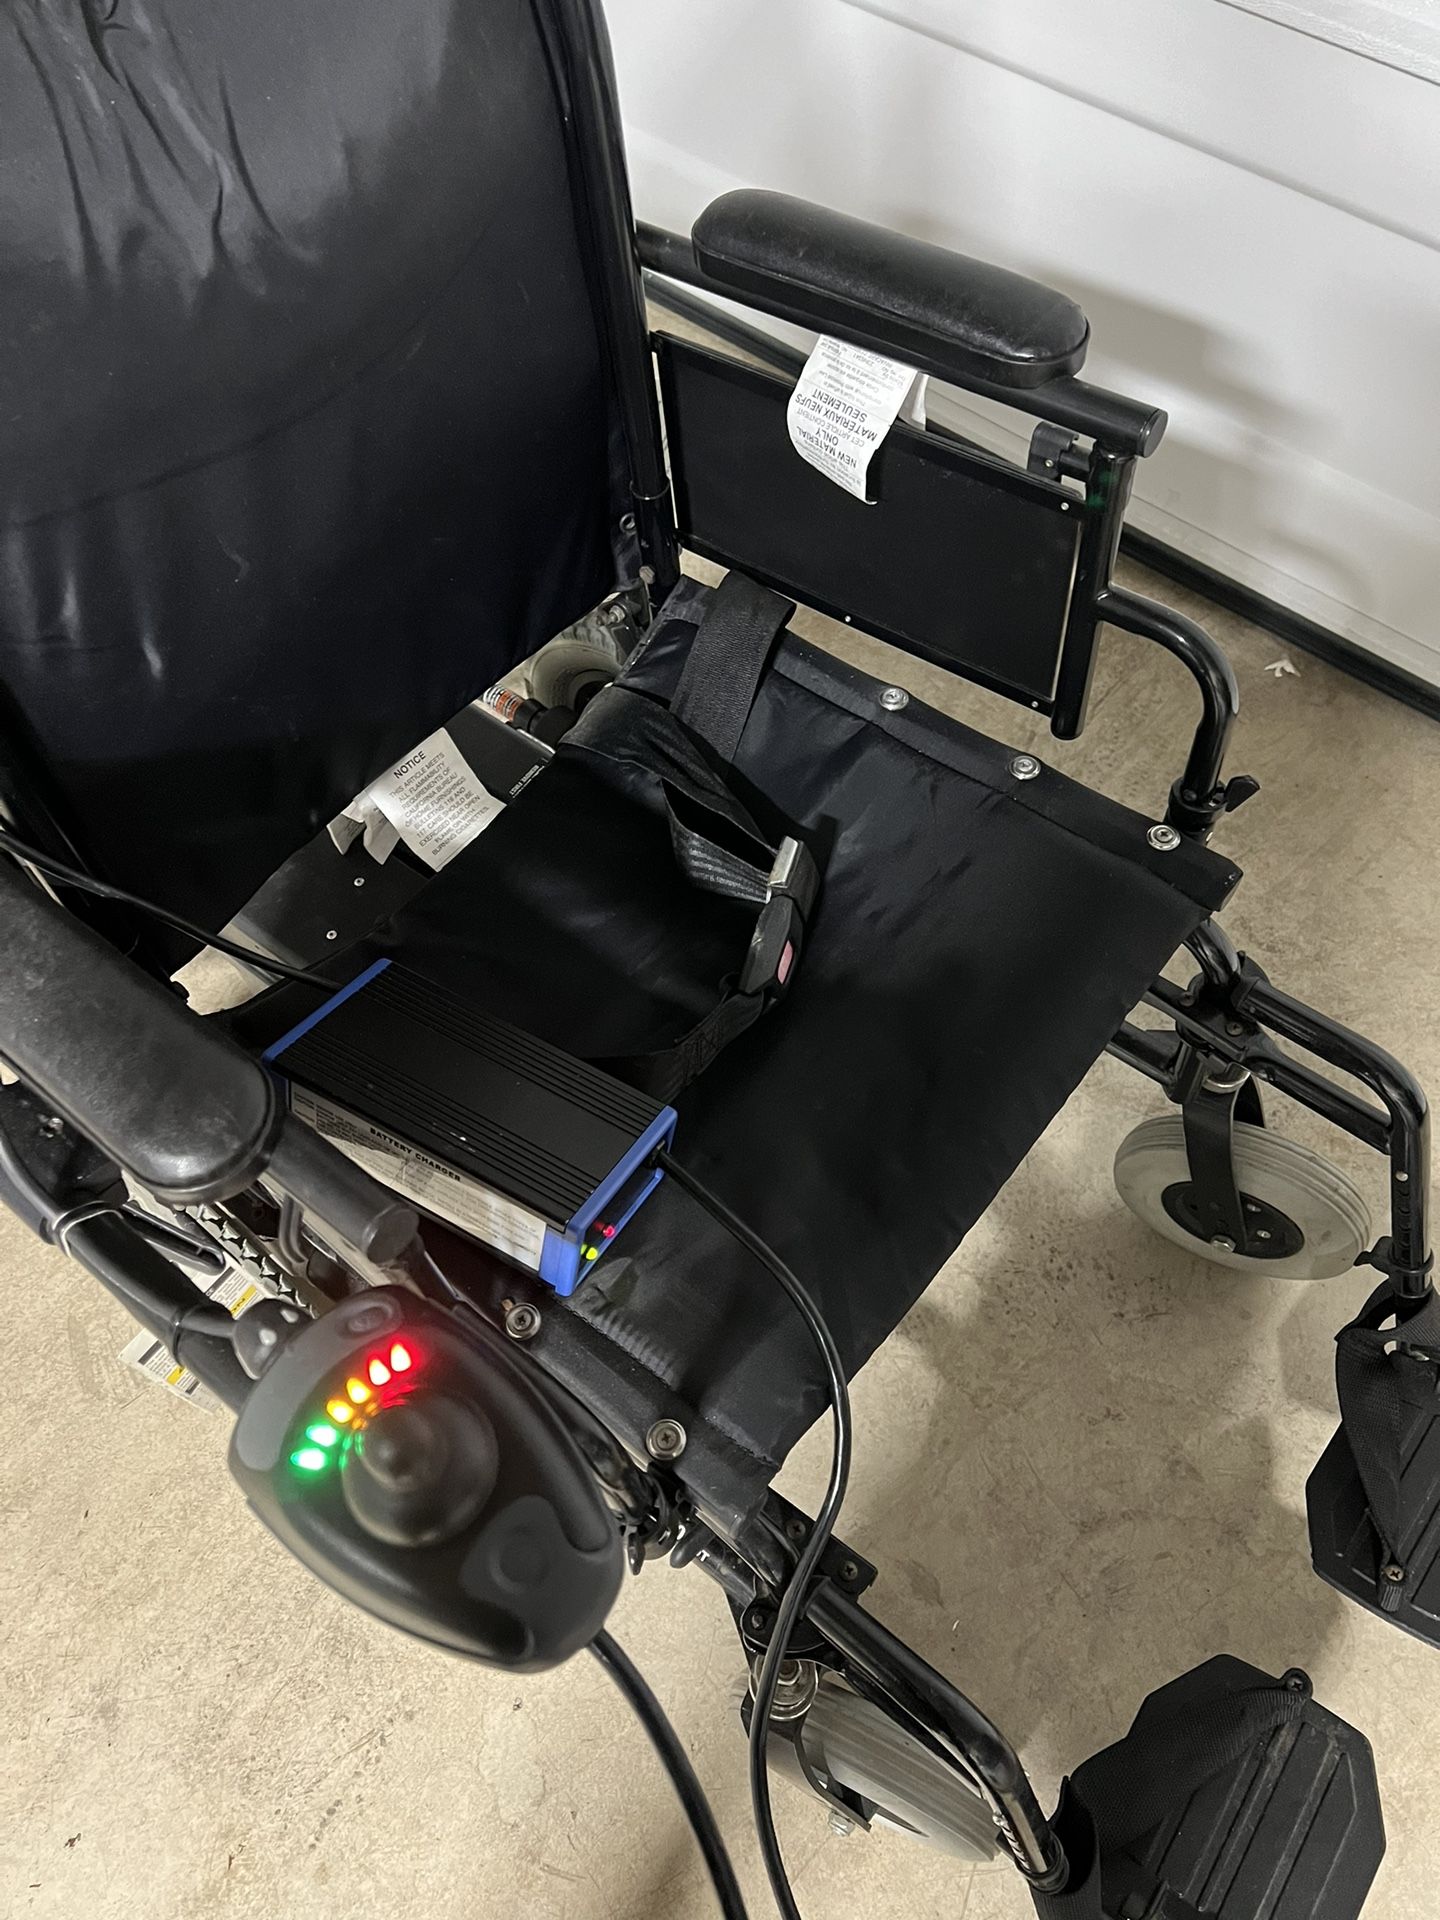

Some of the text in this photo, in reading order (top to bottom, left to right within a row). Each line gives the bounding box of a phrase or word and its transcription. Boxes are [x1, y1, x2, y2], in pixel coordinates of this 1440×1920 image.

[794, 393, 877, 442] MATÉRIAUX NEUFS
[810, 387, 867, 423] SEULEMENT
[793, 425, 856, 467] NEW MATERIAL
[795, 406, 865, 447] CET ARTICLE CONTIENT
[814, 426, 839, 446] ONLY
[389, 751, 445, 798] THIS ARTICLE MEETS
[393, 750, 426, 779] NOTICE
[398, 761, 445, 802] ALL FLAMMABILITY
[401, 766, 451, 810] REQUIREMENTS OF
[404, 789, 437, 818] CALIFORNIA
[435, 771, 458, 792] BUREAU
[411, 803, 431, 821] HOME
[429, 775, 466, 807] FURNISHINGS
[413, 803, 444, 830] BULLETINS
[453, 786, 466, 798] AND
[418, 795, 480, 847] EXERCISED NEAR OPEN
[426, 814, 443, 829] CARE
[441, 796, 465, 817] SHOULD
[464, 790, 474, 799] BE
[433, 807, 476, 843] FLAME OR WITH
[431, 832, 457, 855] BURNING
[369, 1127, 462, 1182] BATTERY CHARGER
